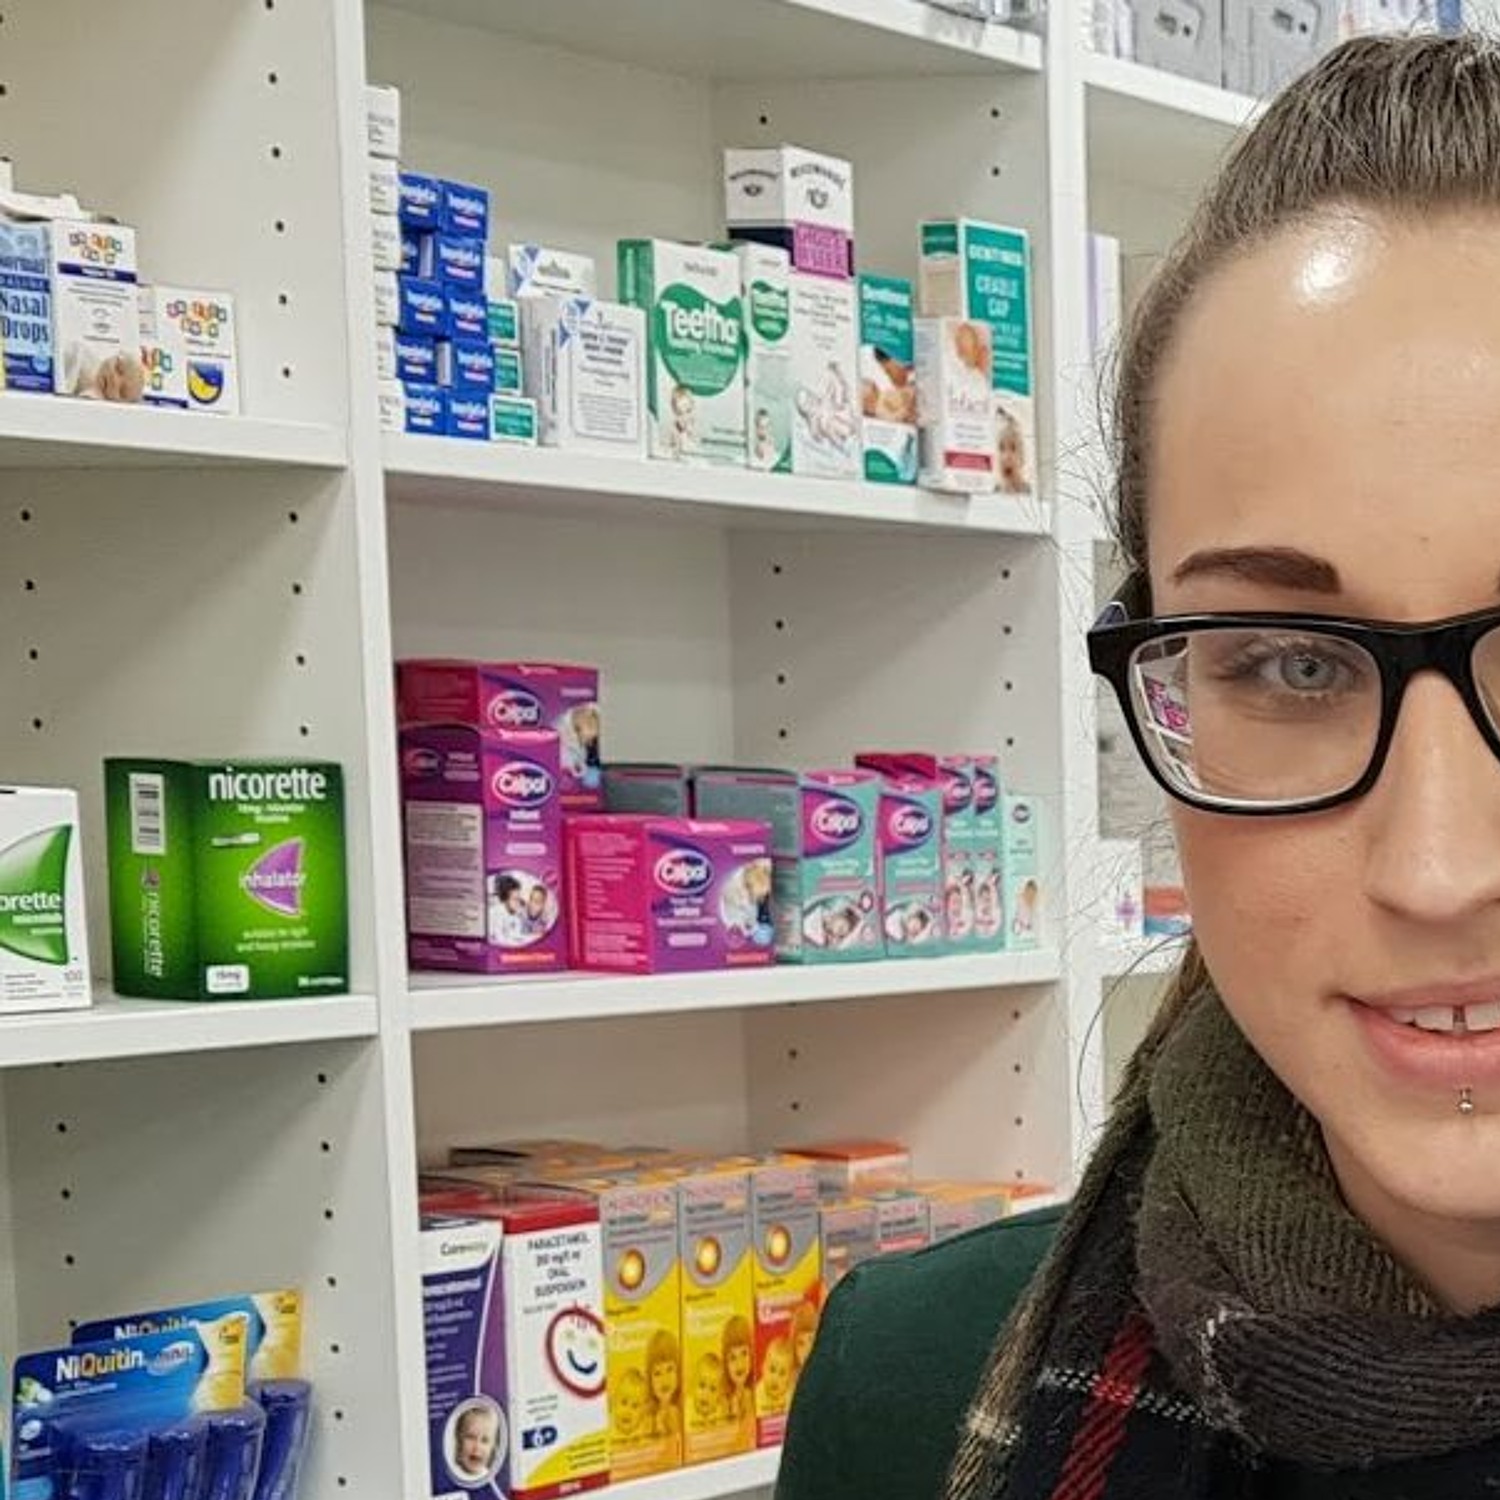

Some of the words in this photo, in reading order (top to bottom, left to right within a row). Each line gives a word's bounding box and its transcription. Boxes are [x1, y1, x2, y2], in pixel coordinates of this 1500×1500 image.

[661, 300, 740, 342] Teetha
[208, 767, 327, 800] nicorette
[526, 1231, 591, 1252] PARACETAMOL
[548, 1266, 570, 1280] ORAL
[56, 1348, 144, 1382] NiQuitin
